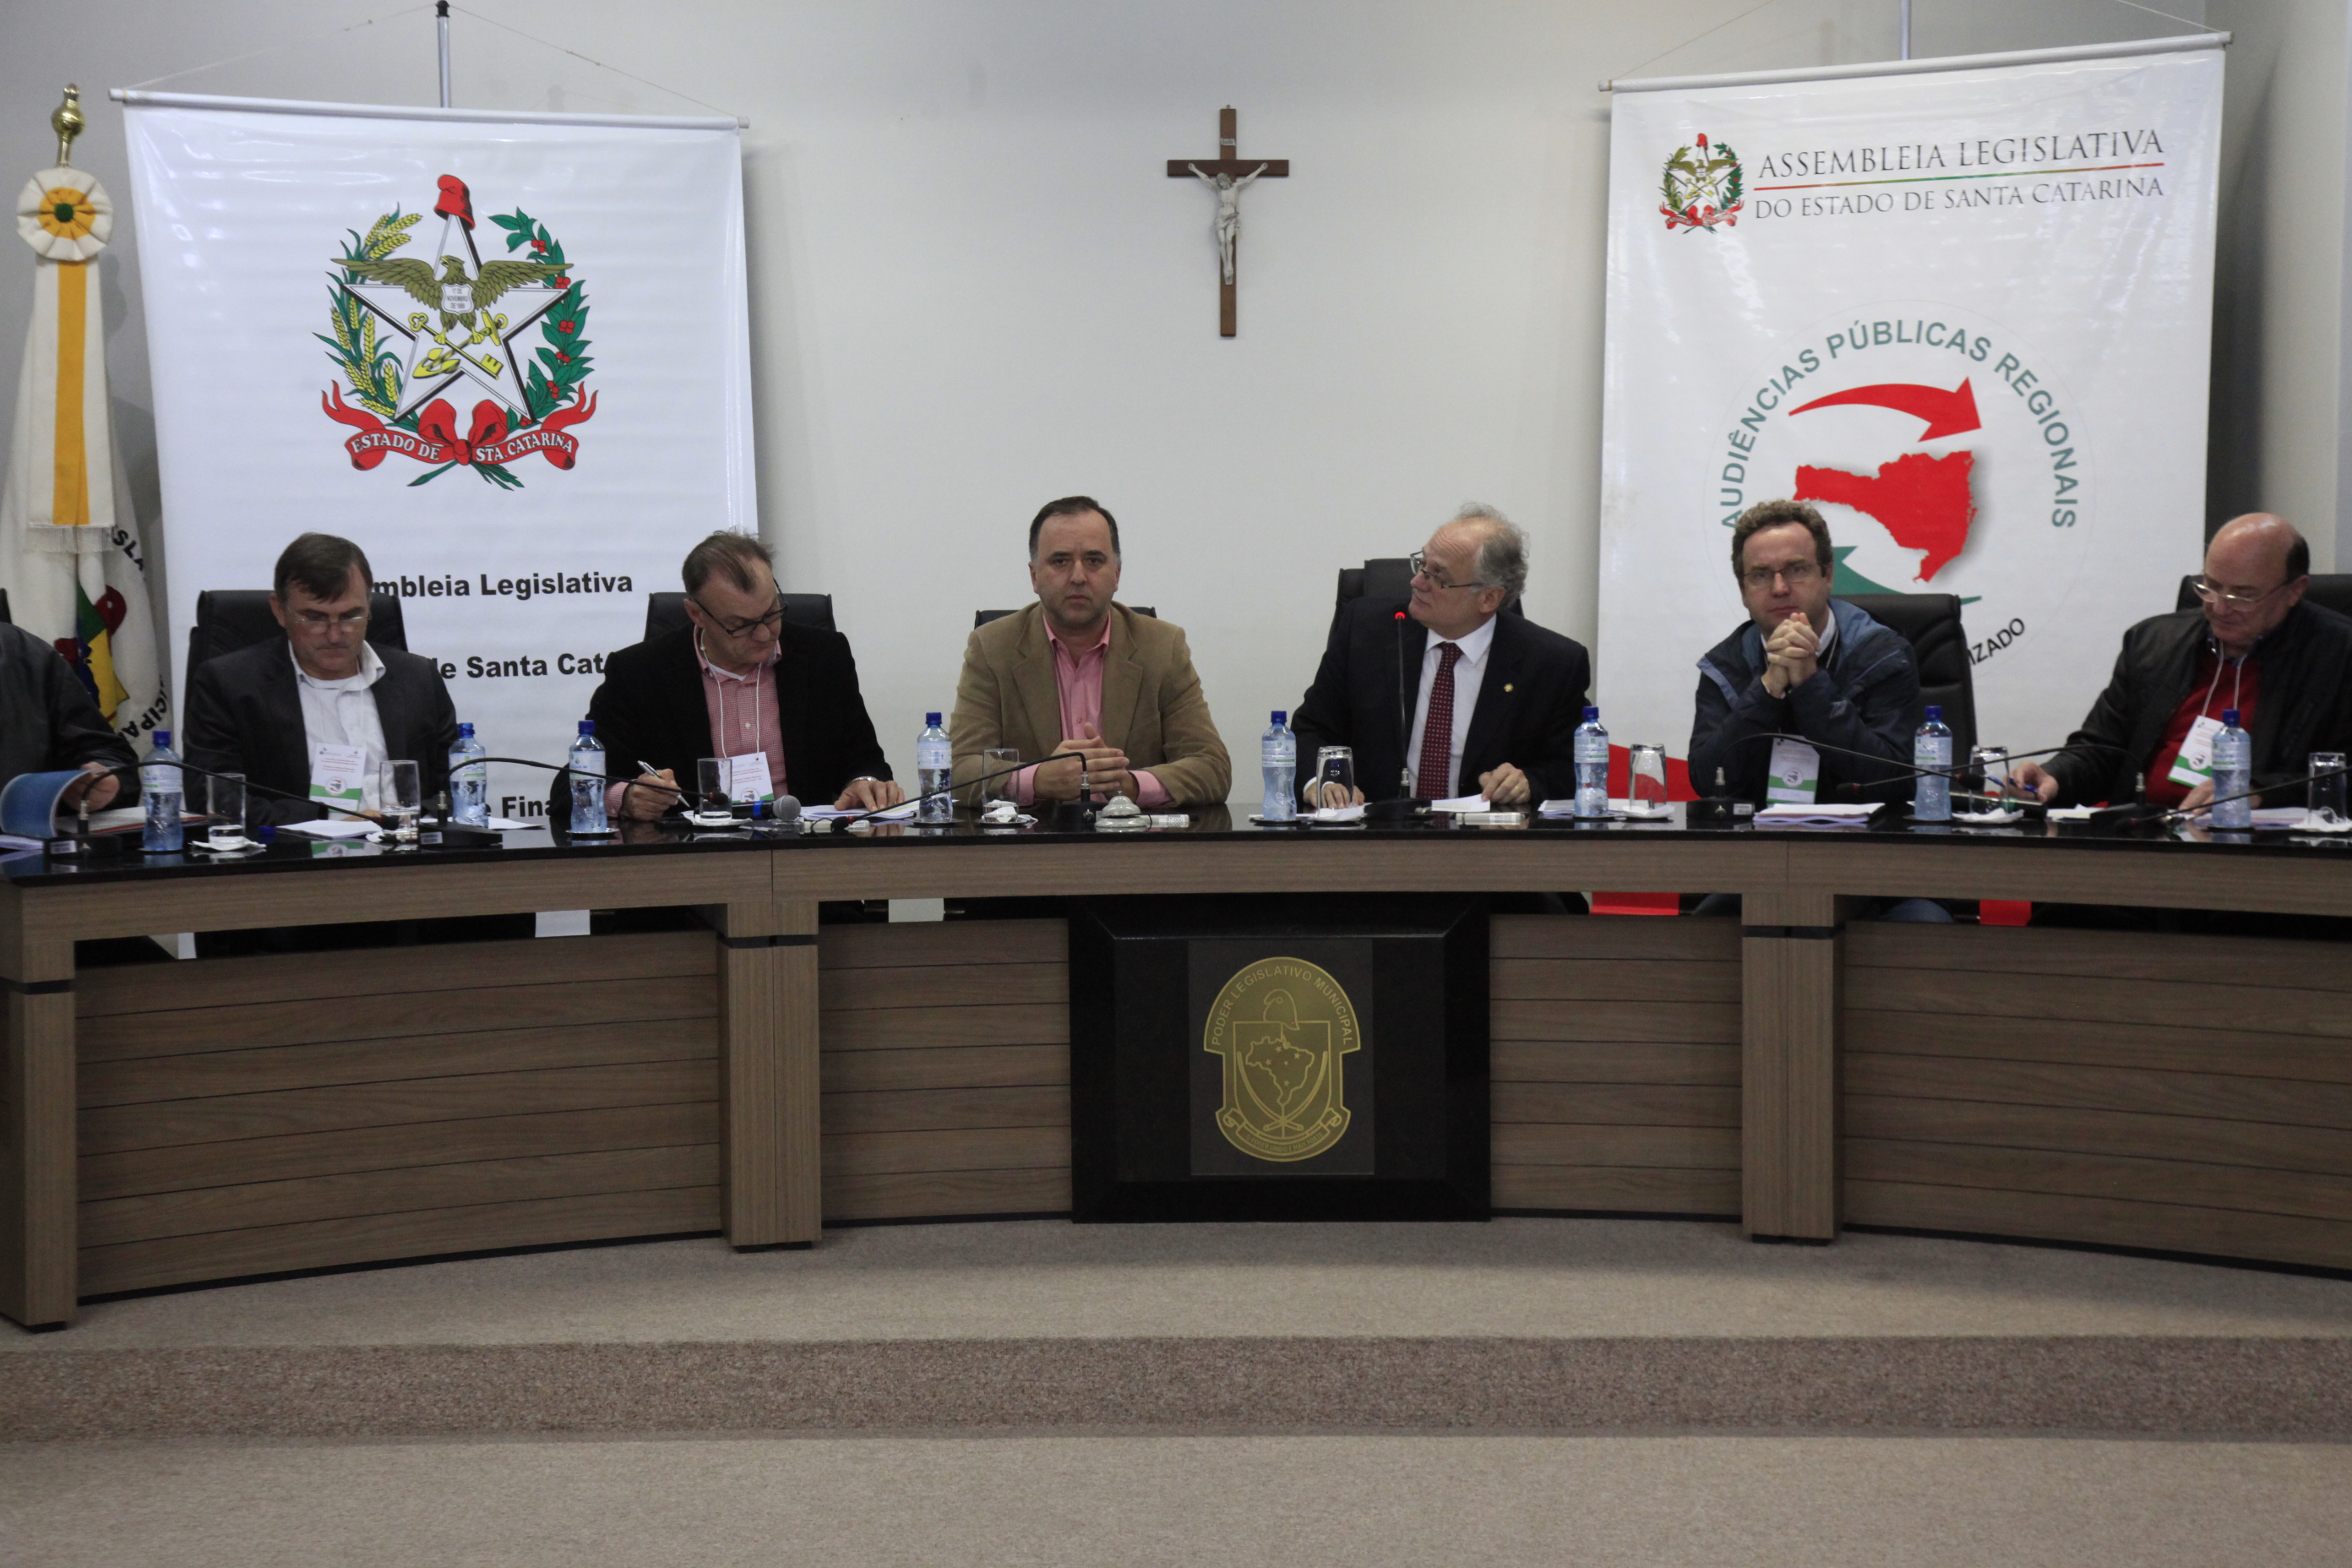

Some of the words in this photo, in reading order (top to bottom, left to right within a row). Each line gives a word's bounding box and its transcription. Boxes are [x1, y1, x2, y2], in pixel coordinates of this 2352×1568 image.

[1758, 144, 1946, 178] ASSEMBLEIA
[1958, 128, 2165, 166] LEGISLATIVA
[1755, 199, 1792, 219] DO
[1801, 193, 1894, 216] ESTADO
[1904, 191, 1935, 210] DE
[1945, 186, 2024, 209] SANTA
[2032, 177, 2164, 204] CATARINA
[350, 433, 416, 454] ESTADO
[417, 444, 441, 461] DE
[508, 432, 574, 456] CATARINA
[1720, 348, 1821, 529] AUDIÊNCIAS
[1826, 319, 1992, 362] PÚBLICAS
[1993, 351, 2079, 528] REGIONAIS
[373, 574, 471, 598] mbleia
[480, 571, 634, 601] Legislativa
[1968, 618, 2025, 666] IZADO
[432, 657, 457, 679] e
[466, 655, 548, 678] Santa
[558, 652, 606, 675] Cat
[1211, 999, 1234, 1046] PODER
[1230, 966, 1312, 999] LEGISLATIVO
[1314, 977, 1353, 1046] MUNICIPAL
